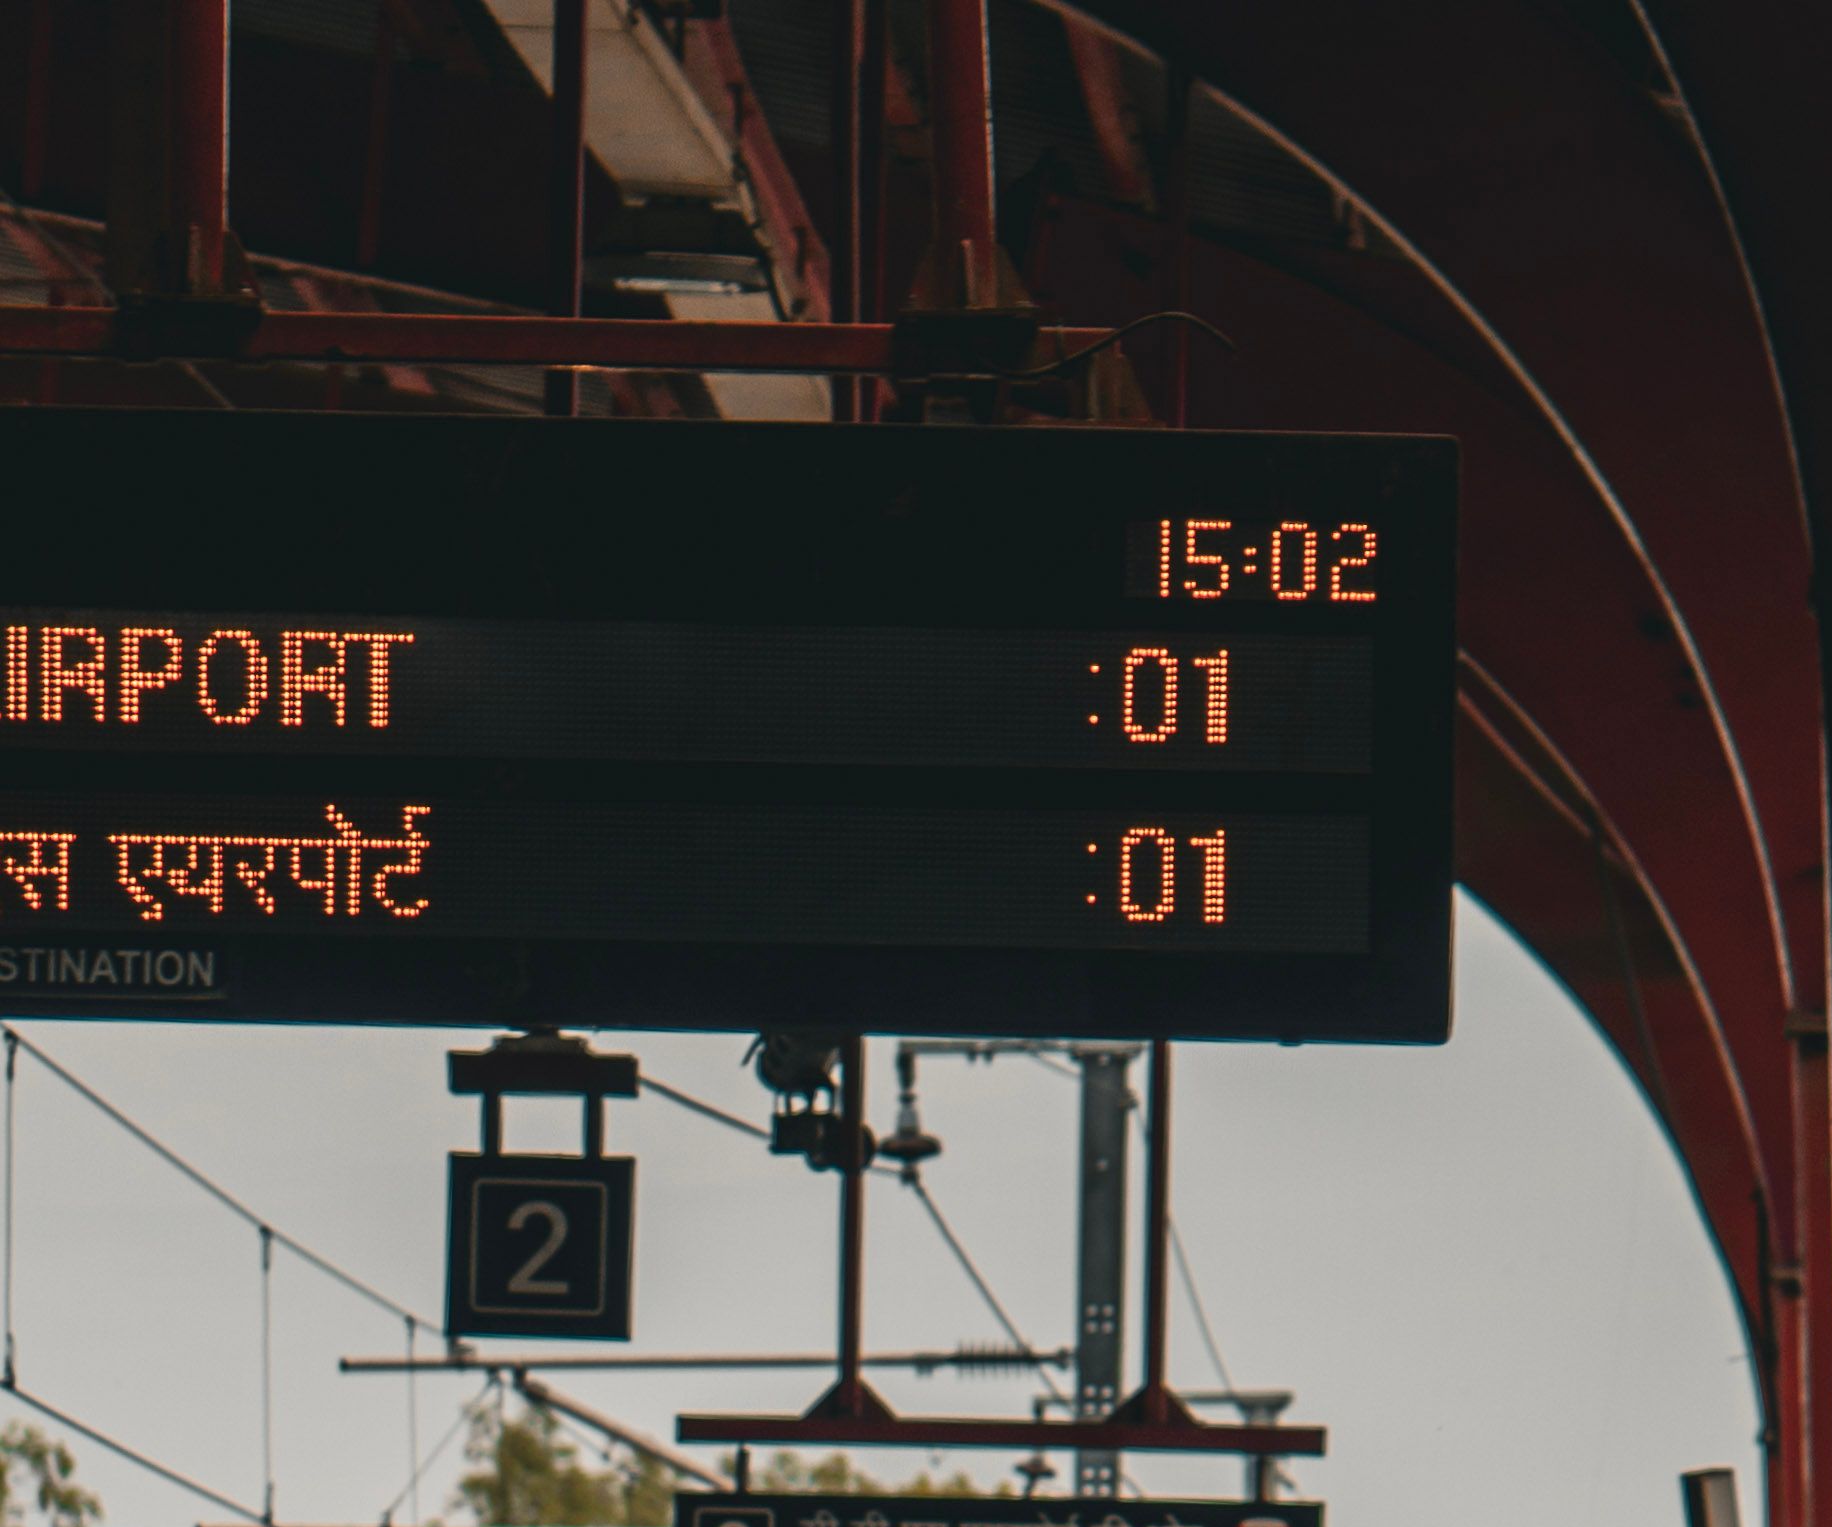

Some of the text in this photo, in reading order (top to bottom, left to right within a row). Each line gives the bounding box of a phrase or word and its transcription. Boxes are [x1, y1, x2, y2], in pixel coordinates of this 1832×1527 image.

[1158, 518, 1377, 602] 15:02
[2, 625, 415, 728] IRPORT
[0, 802, 431, 921] स एयरपोर्ट
[506, 1200, 570, 1295] 2
